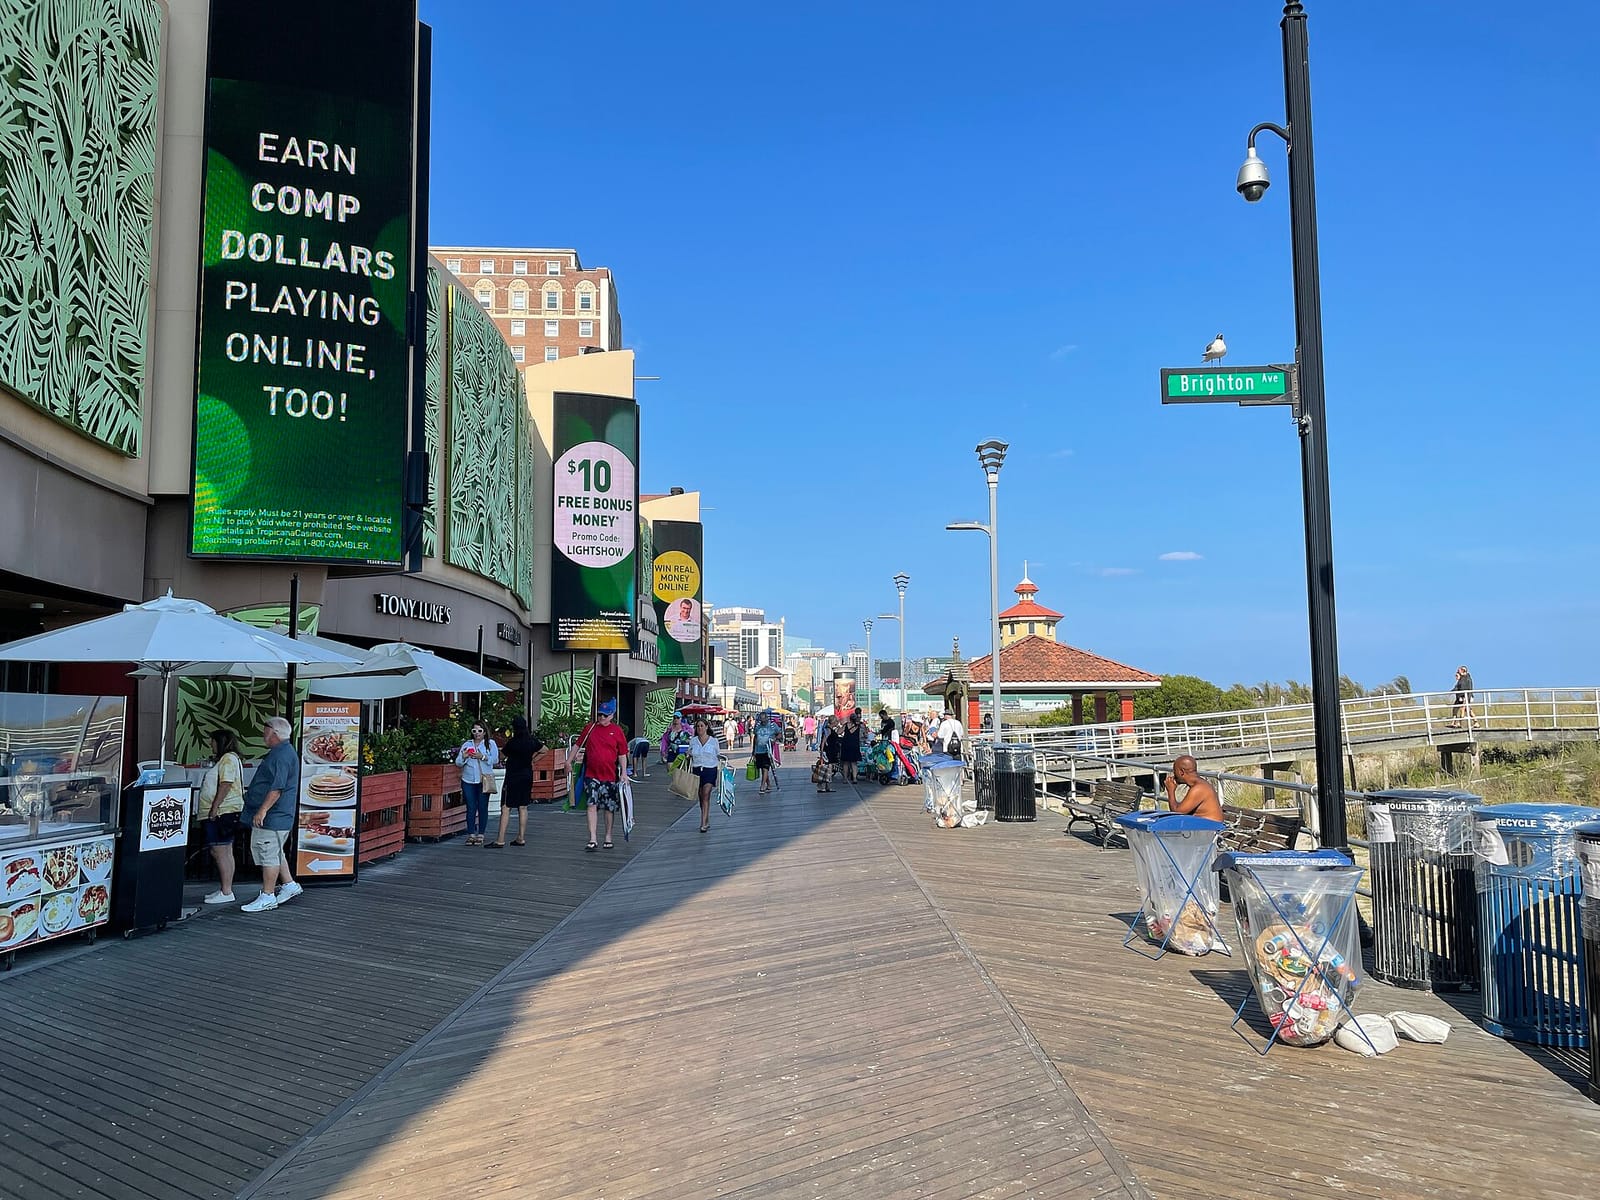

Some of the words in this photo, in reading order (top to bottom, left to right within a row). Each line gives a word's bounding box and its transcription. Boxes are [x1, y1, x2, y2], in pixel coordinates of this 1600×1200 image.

[258, 132, 357, 175] EARN
[251, 182, 361, 223] COMP
[221, 229, 395, 280] DOLLARS
[225, 280, 381, 326] PLAYING
[225, 332, 376, 381] ONLINE,
[1180, 374, 1255, 396] Brighton
[1261, 373, 1279, 383] Ave
[262, 385, 347, 422] TOO!
[567, 458, 612, 493] $10
[558, 496, 590, 508] FREE
[593, 497, 633, 512] BONUS
[280, 509, 291, 517] be
[292, 510, 302, 518] 21
[304, 512, 326, 520] years
[337, 513, 355, 521] over
[356, 514, 363, 522] &
[365, 514, 392, 524] located
[213, 517, 225, 525] NJ
[226, 517, 235, 525] to
[256, 518, 274, 526] Void
[275, 519, 302, 528] where
[302, 520, 345, 530] prohibited.
[346, 522, 361, 531] See
[362, 524, 392, 533] website
[216, 526, 245, 535] details
[203, 535, 243, 545] Gambling
[243, 536, 283, 545] problem?
[284, 538, 301, 546] Call
[571, 531, 598, 541] Promo
[599, 533, 620, 543] Code:
[567, 545, 624, 557] LIGHTSHOW
[673, 565, 695, 574] REAL
[660, 574, 690, 582] MONEY
[380, 594, 415, 617] TONY
[418, 601, 451, 625] LUKE'S
[1495, 818, 1537, 828] RECYCLE
